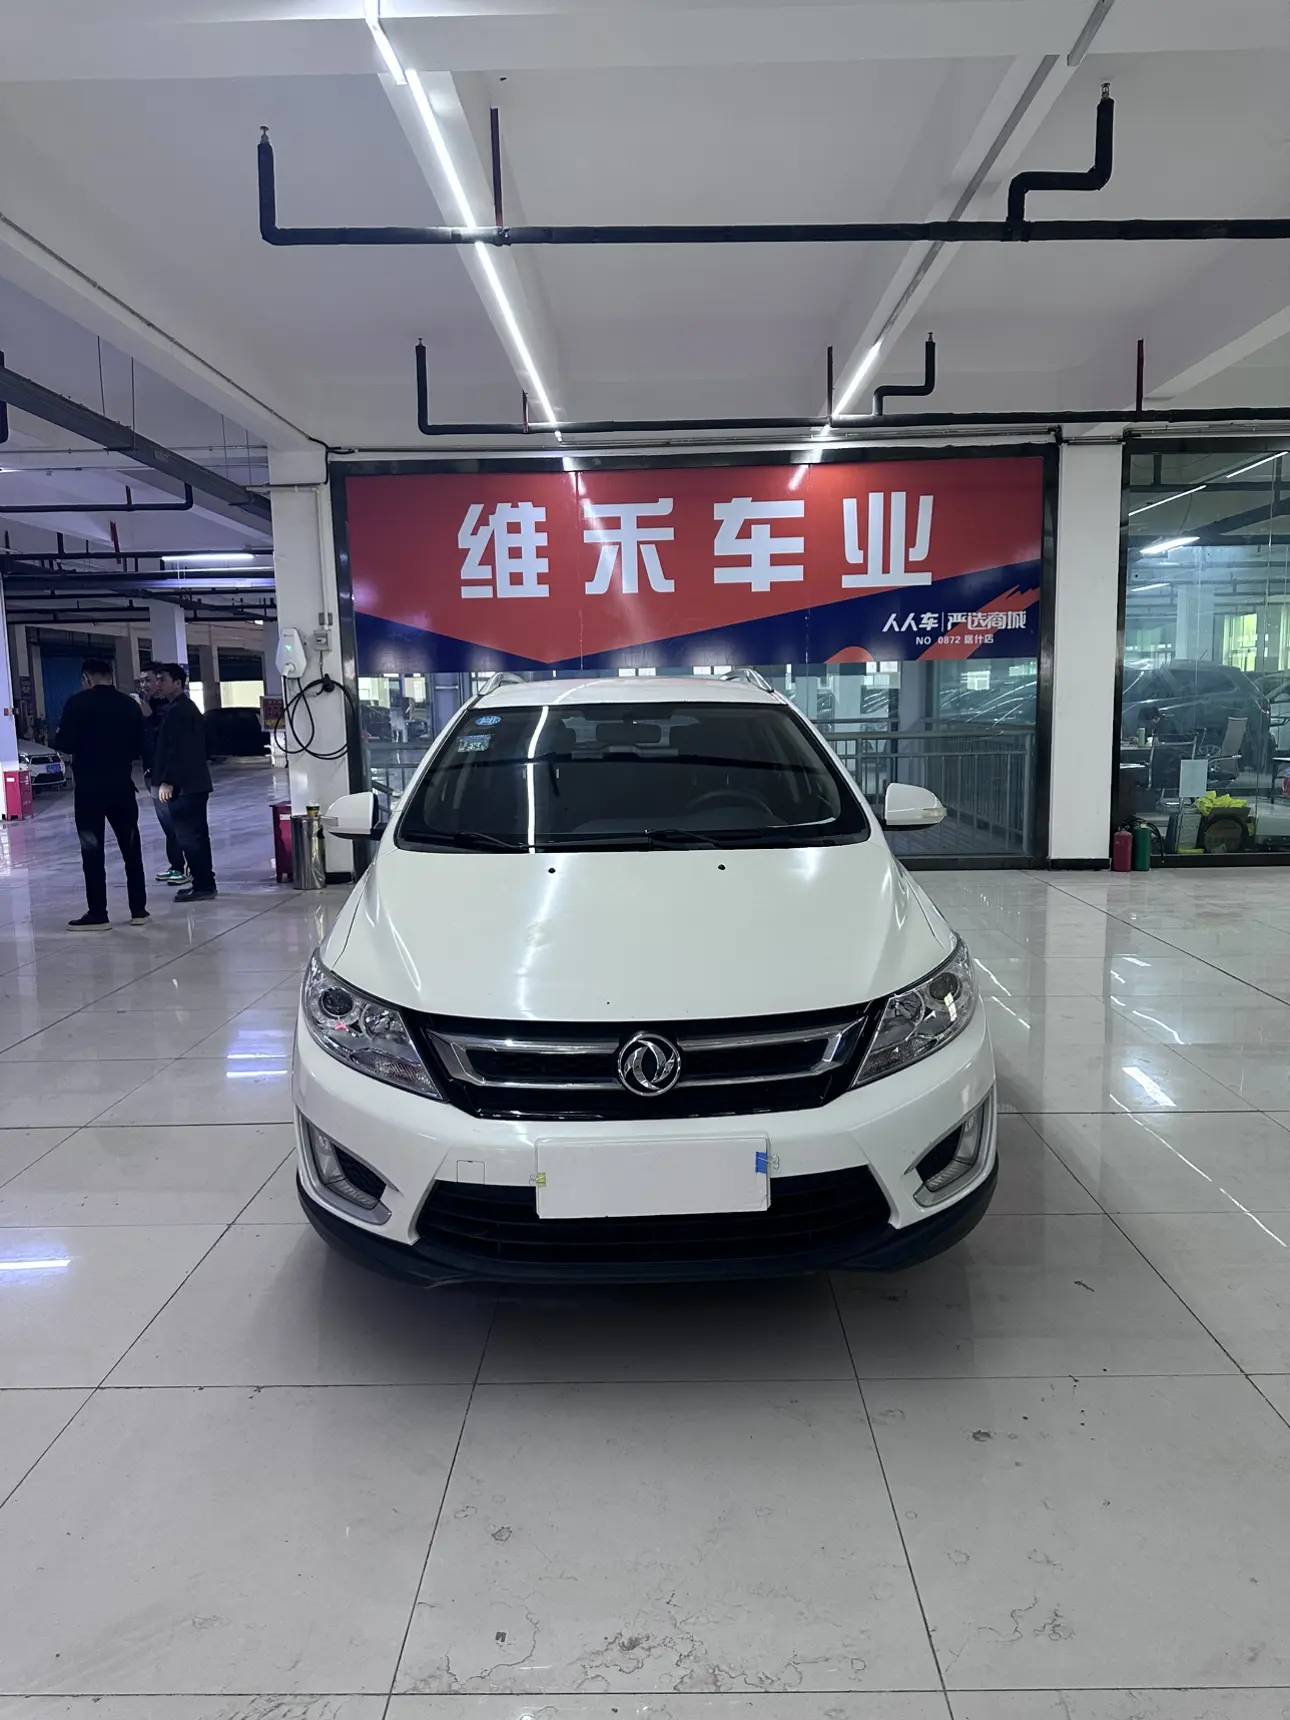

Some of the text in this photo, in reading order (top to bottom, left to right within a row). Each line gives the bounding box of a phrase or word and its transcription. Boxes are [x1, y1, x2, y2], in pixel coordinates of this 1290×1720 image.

[458, 491, 934, 598] 维禾车业
[882, 611, 1026, 632] 人人车 严选商城
[938, 635, 961, 645] 0872
